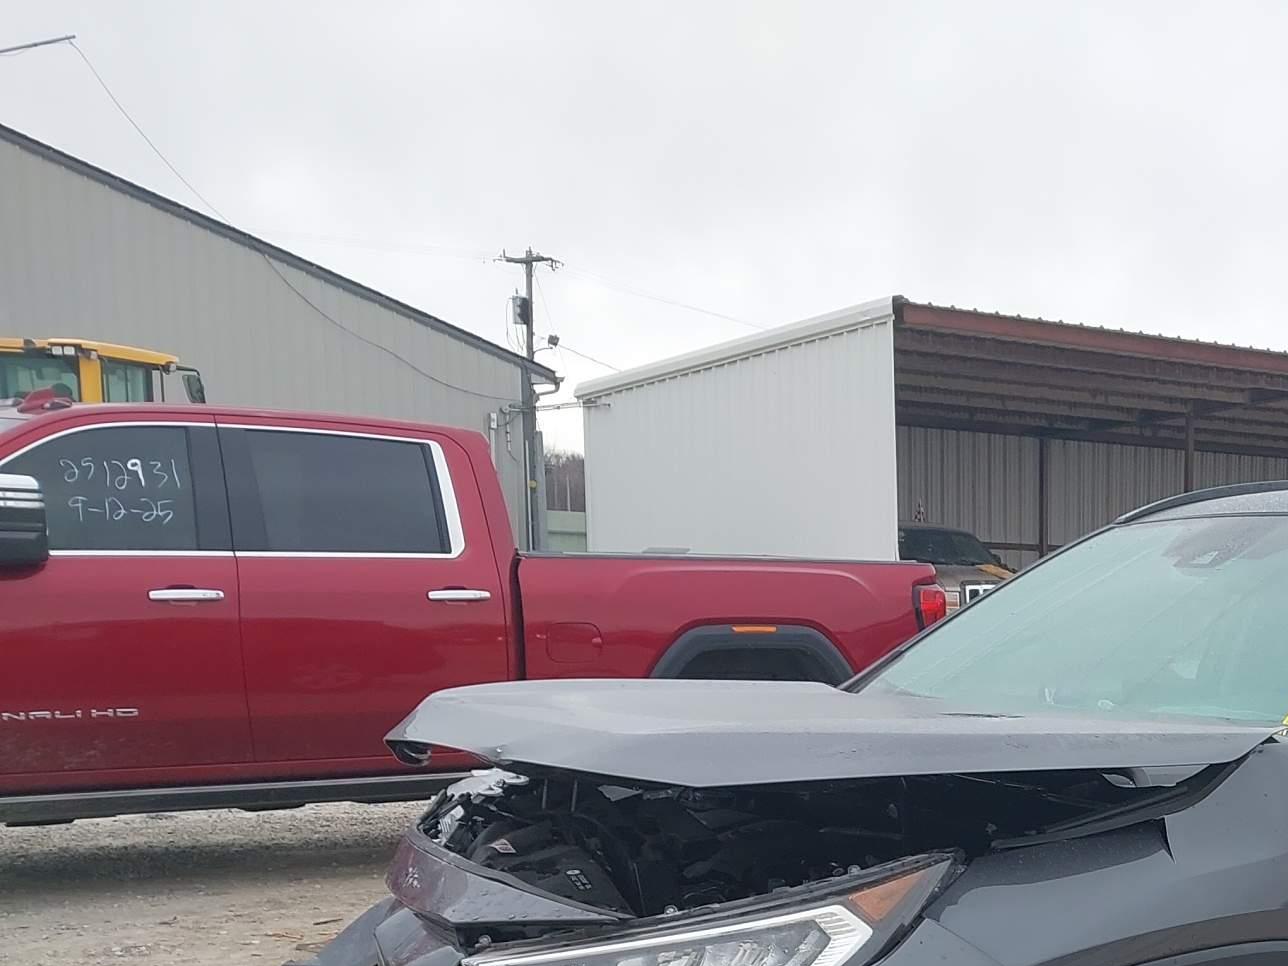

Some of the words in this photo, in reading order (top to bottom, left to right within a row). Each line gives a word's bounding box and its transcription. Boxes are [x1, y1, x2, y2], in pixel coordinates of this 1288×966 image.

[59, 457, 181, 490] 2512931
[67, 496, 174, 525] 9-12-25
[90, 708, 139, 718] HD
